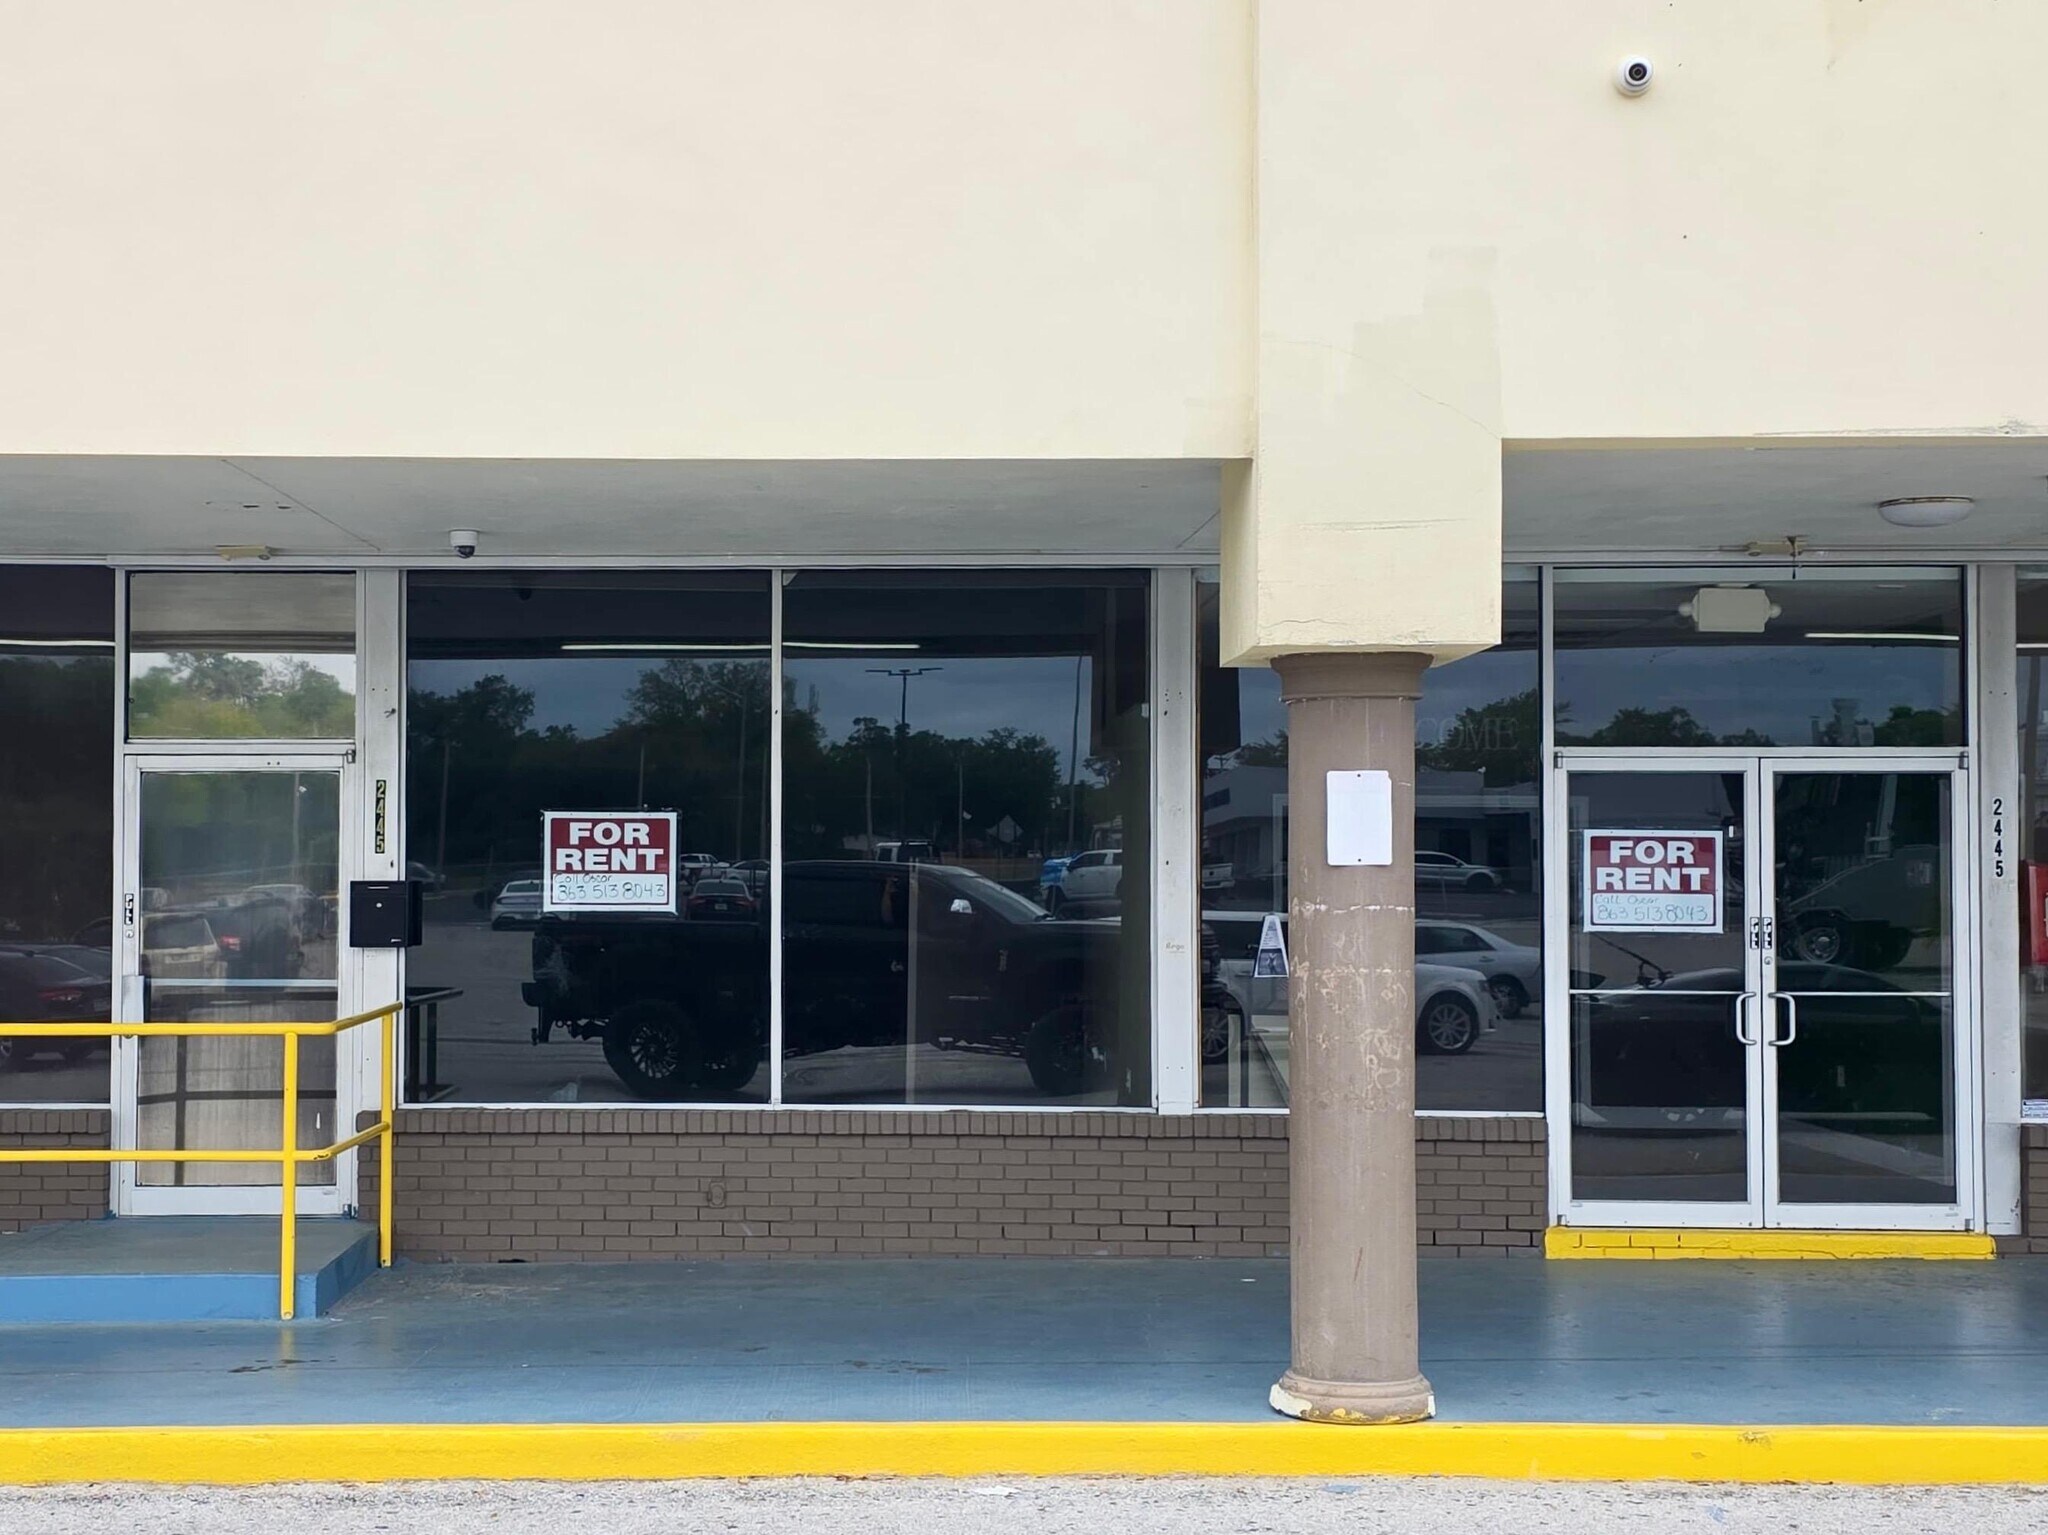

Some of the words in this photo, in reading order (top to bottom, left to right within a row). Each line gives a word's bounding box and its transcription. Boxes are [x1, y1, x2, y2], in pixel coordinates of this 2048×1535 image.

[376, 781, 385, 853] 2445
[569, 821, 650, 846] FOR
[1993, 798, 2004, 878] 2445
[555, 847, 665, 871] RENT
[1609, 840, 1695, 864] FOR
[592, 883, 619, 899] 513
[1596, 867, 1710, 891] RENT
[125, 894, 133, 925] PULL
[1634, 905, 1663, 922] 513
[1664, 903, 1709, 923] 8043
[1751, 917, 1759, 949] PULL
[1763, 917, 1772, 949] PULL
